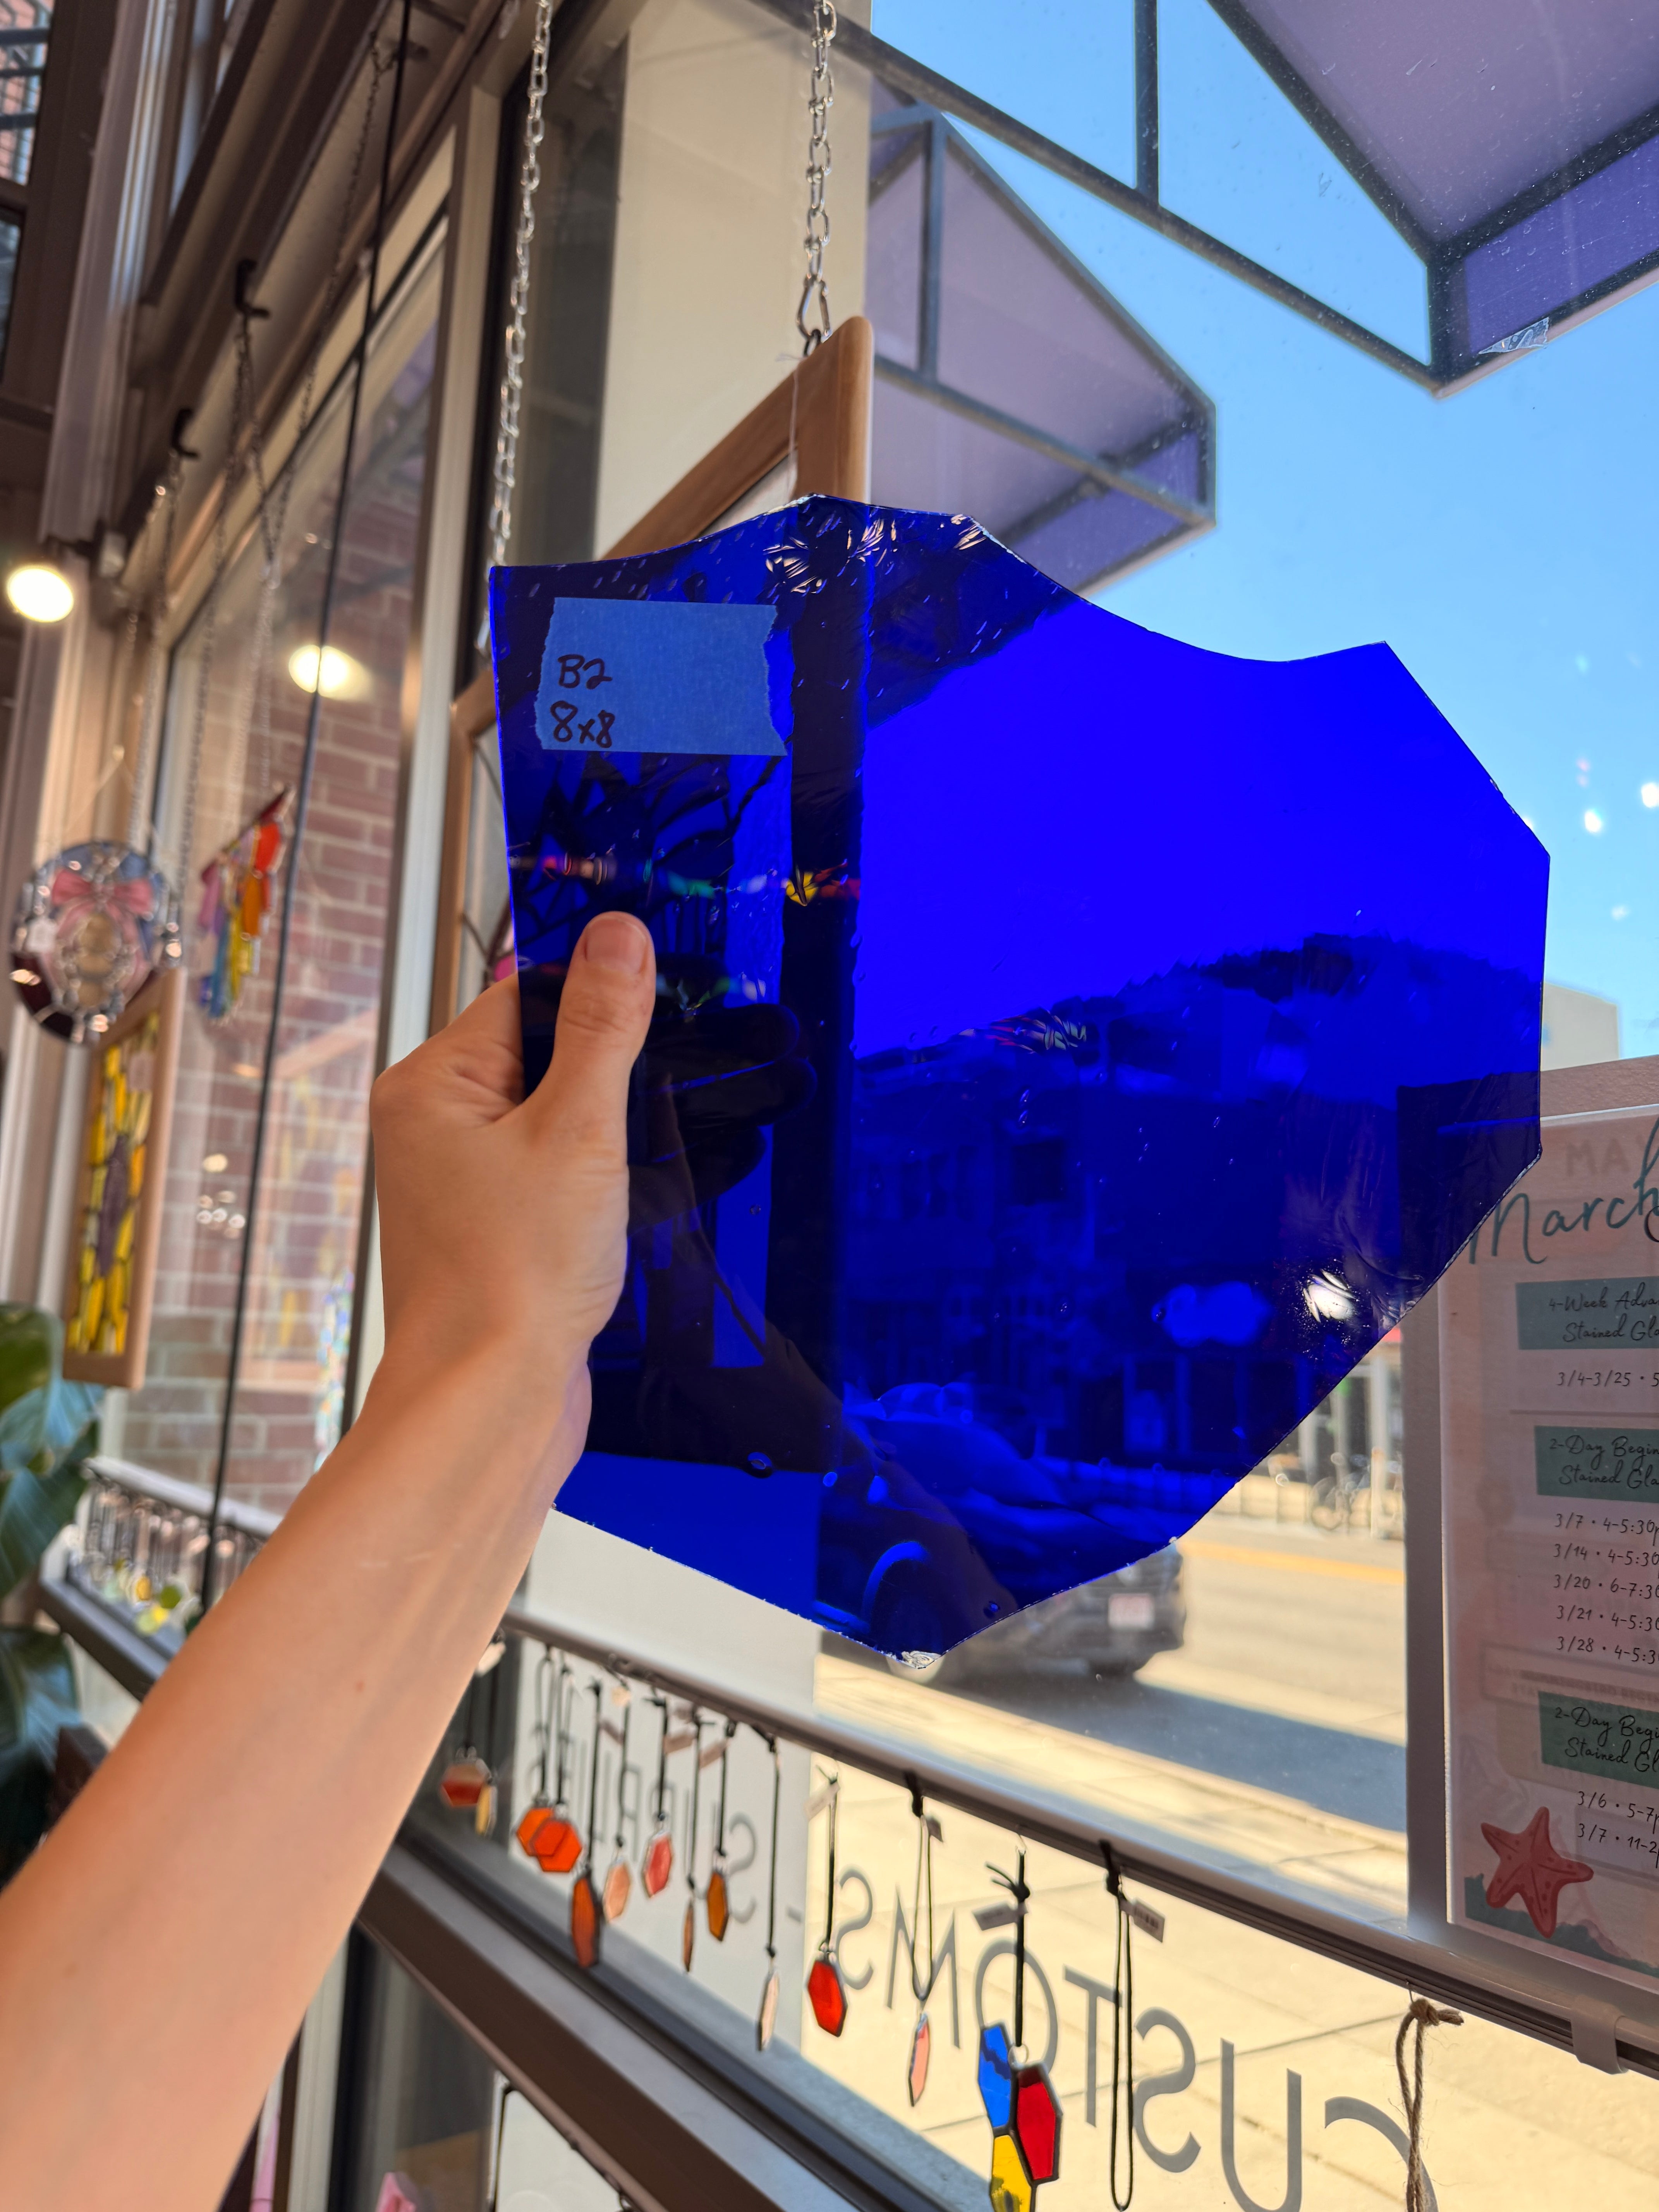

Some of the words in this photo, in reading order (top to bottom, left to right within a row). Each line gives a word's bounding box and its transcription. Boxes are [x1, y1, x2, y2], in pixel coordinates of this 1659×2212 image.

[558, 654, 613, 689] B2
[1469, 1117, 1659, 1264] March
[1549, 1286, 1608, 1312] 4-Week
[1614, 1281, 1659, 1312] Adva
[1563, 1313, 1625, 1342] Stained
[1556, 1370, 1632, 1387] 3/4-3/25
[1549, 1435, 1606, 1470] 2-Day
[1559, 1459, 1621, 1485] Stained
[1554, 1512, 1583, 1529] 3/7
[1553, 1542, 1587, 1561] 3/14
[1553, 1573, 1590, 1590] 3/20
[1556, 1605, 1592, 1621] 3/21
[1556, 1636, 1594, 1652] 3/28
[1614, 1645, 1659, 1664] 4-5:3
[1554, 1707, 1613, 1747] 2-Day
[1565, 1737, 1629, 1764] Stained
[1577, 1791, 1607, 1809] 3/6
[1577, 1823, 1607, 1843] 3/7
